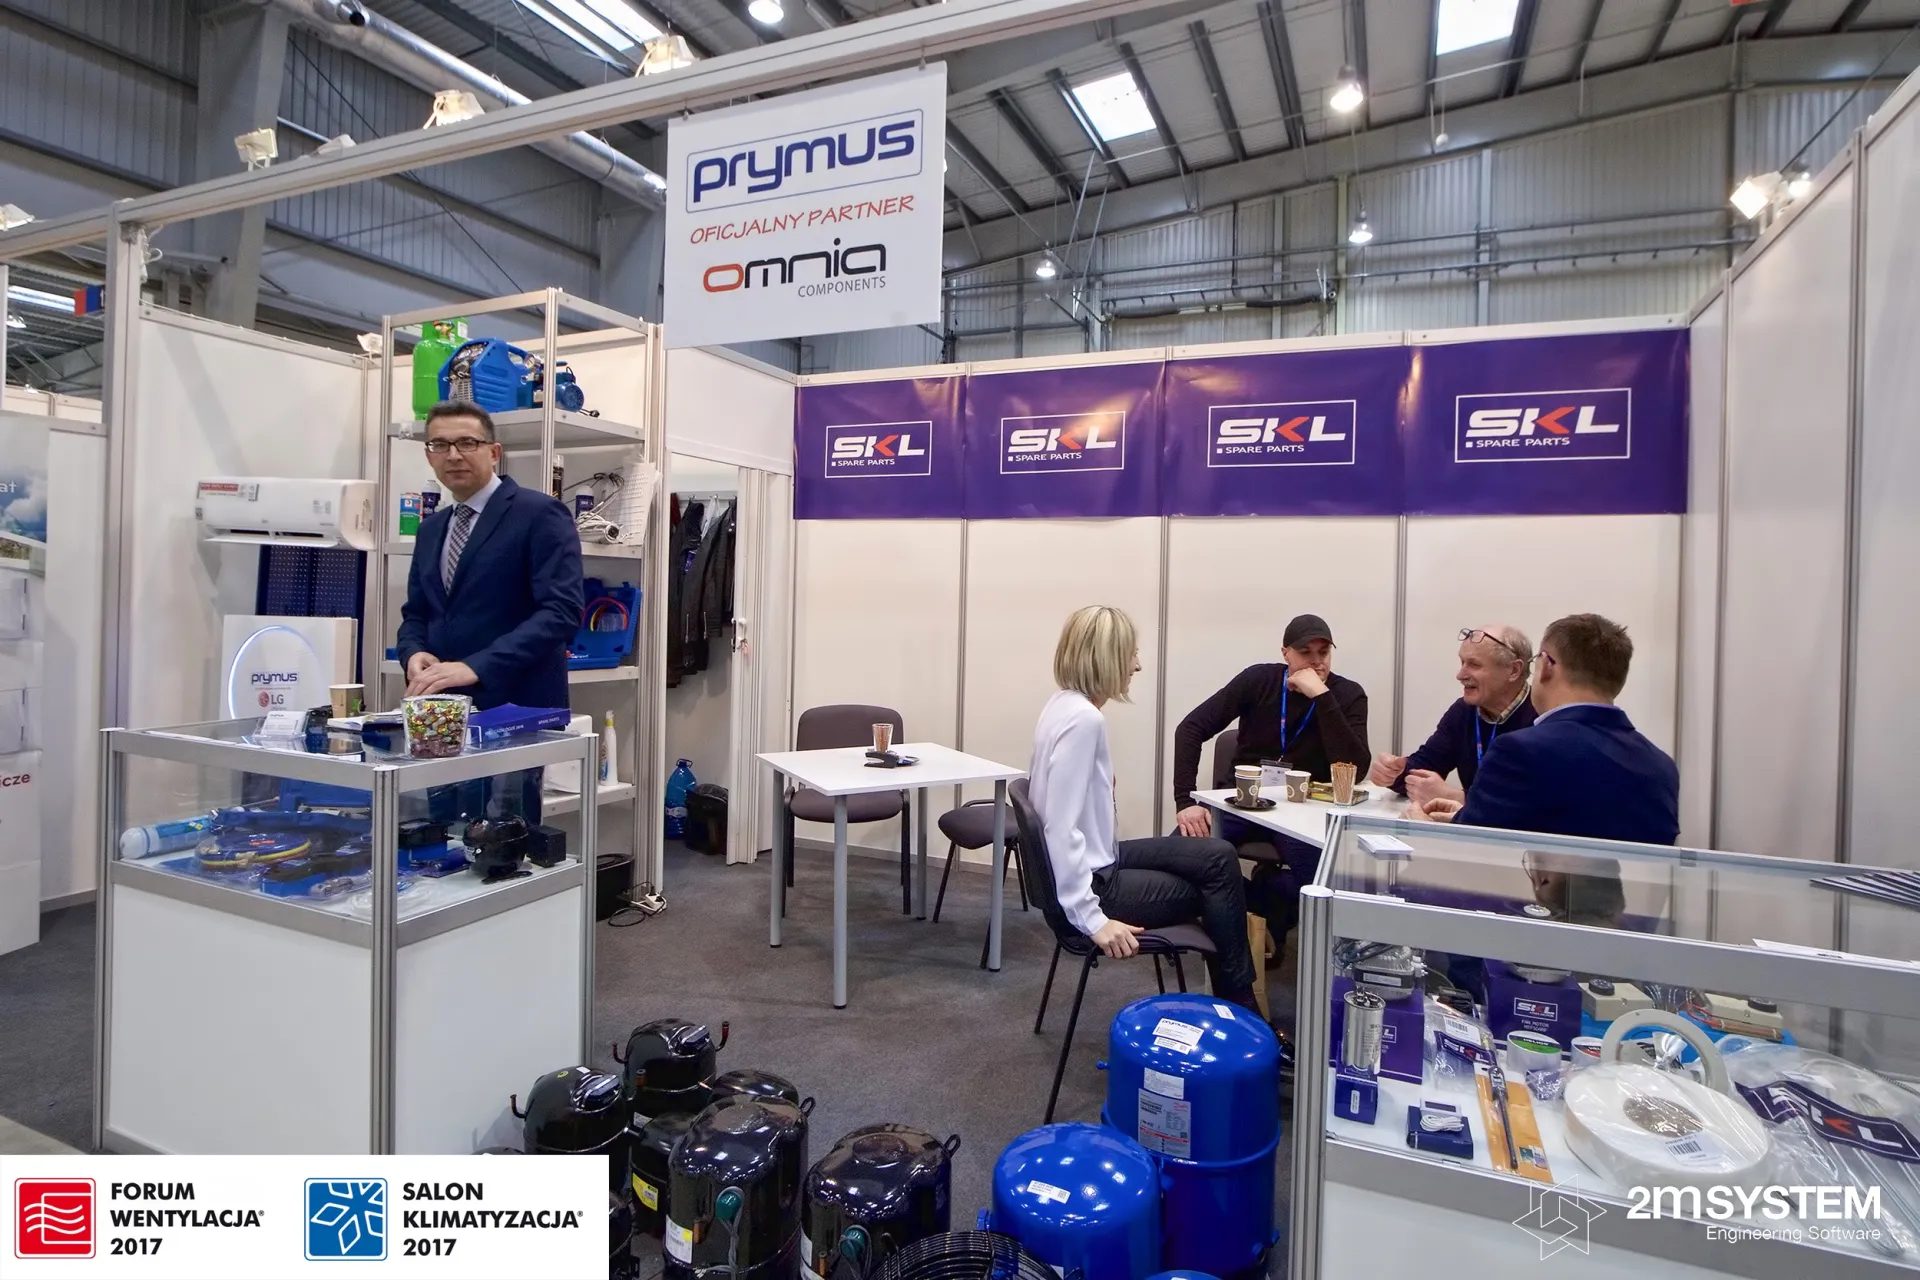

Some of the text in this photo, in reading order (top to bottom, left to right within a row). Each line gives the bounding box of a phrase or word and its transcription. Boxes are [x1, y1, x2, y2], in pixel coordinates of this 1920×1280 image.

[693, 120, 915, 203] prymus
[690, 195, 914, 245] OFICJALNY PARTNER
[703, 237, 886, 293] omnia
[798, 276, 886, 298] COMPONENTS
[1216, 416, 1346, 444] SKL
[1465, 405, 1620, 437] SKL
[832, 434, 925, 458] SKL
[1008, 425, 1117, 453] SKL
[1225, 444, 1305, 454] SPARE PARTS
[1476, 436, 1571, 448] SPARE PARTS
[837, 458, 896, 467] SPARE PARTS
[1015, 452, 1082, 462] SPARE PARTS
[252, 673, 298, 685] prymus
[271, 694, 284, 705] LG
[1517, 1002, 1555, 1015] SKL
